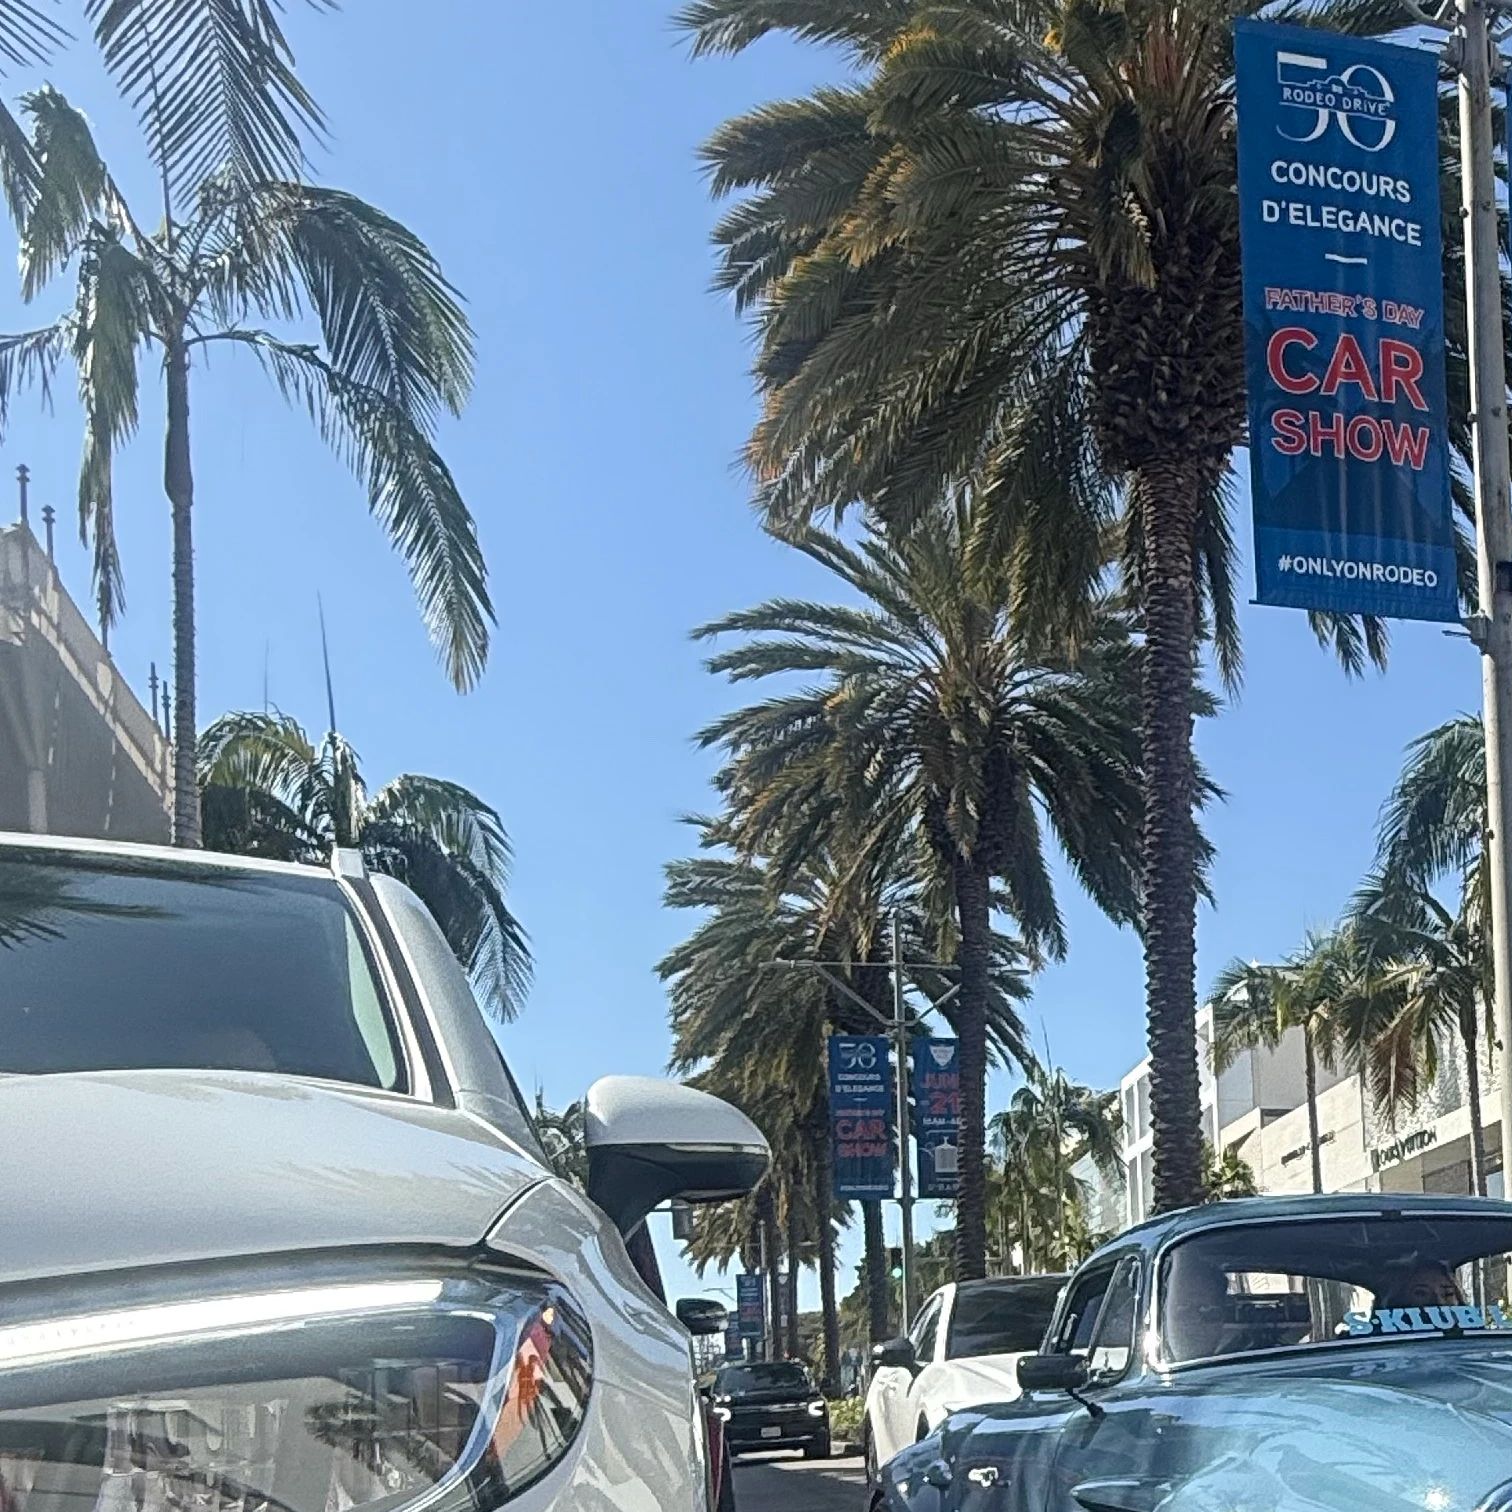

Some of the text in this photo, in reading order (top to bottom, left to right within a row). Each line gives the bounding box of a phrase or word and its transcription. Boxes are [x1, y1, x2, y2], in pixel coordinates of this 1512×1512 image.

[1282, 87, 1388, 115] RODEO DRIVE
[1271, 160, 1411, 203] CONCOURS
[1262, 199, 1422, 247] D'ELEGANCE
[1264, 287, 1424, 329] FATHER'S DAY
[1267, 327, 1430, 412] CAR
[1271, 409, 1430, 471] SHOW
[1278, 554, 1438, 588] #ONLYONRODEO
[920, 1072, 960, 1089] JUN
[836, 1119, 888, 1140] CAR
